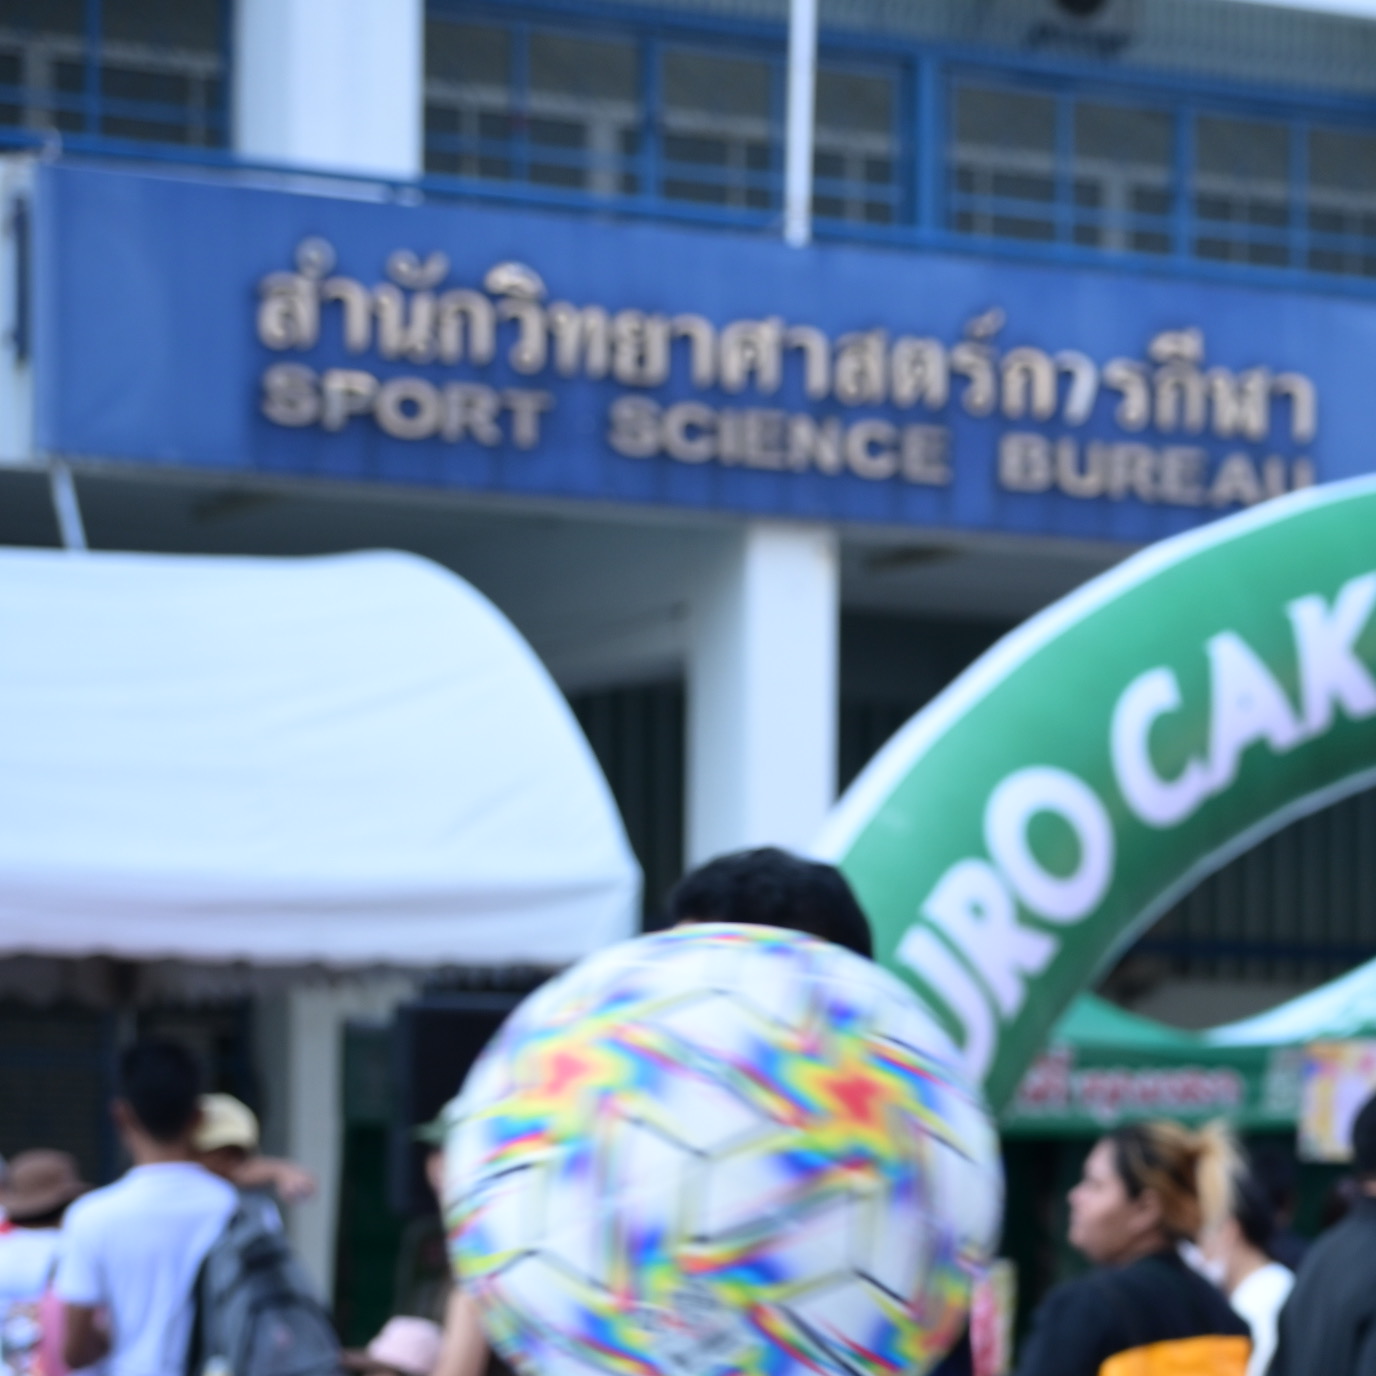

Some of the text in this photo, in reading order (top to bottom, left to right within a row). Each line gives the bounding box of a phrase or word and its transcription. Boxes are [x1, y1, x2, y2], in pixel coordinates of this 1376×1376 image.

[257, 236, 1317, 443] สำนักวิทยาศาสตร์การกีฬา
[262, 362, 1314, 506] SPORT SCIENCE BUREAU
[893, 764, 1115, 1092] URO
